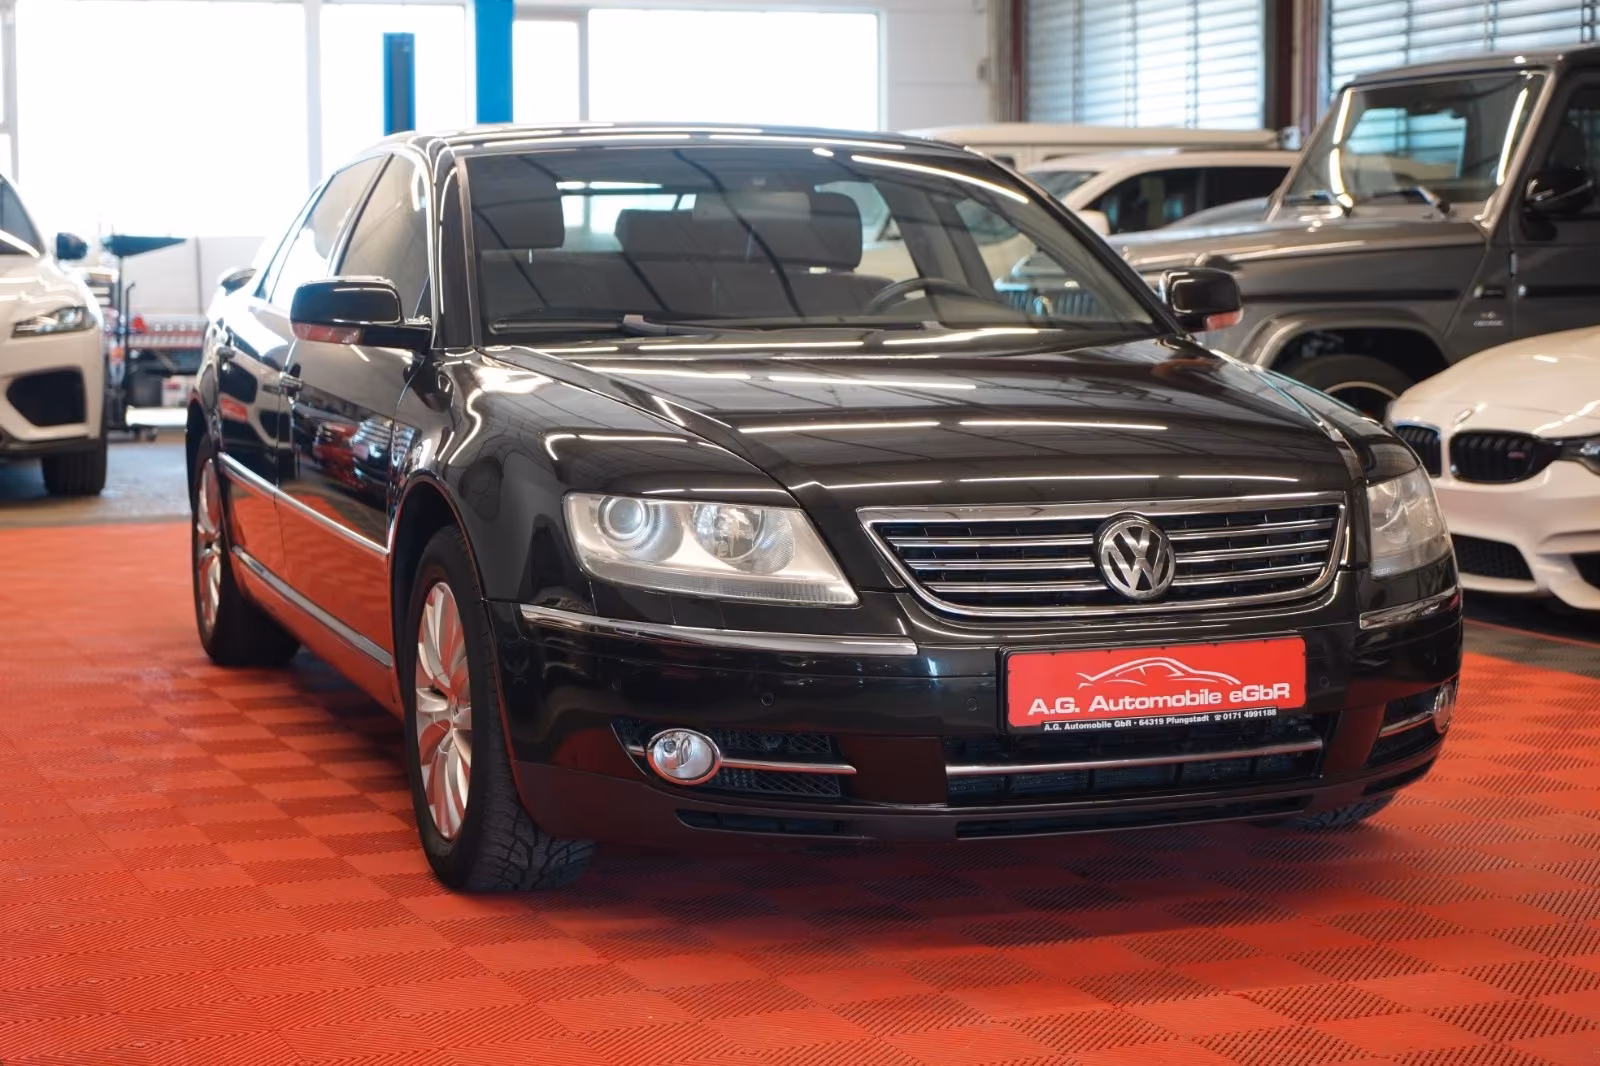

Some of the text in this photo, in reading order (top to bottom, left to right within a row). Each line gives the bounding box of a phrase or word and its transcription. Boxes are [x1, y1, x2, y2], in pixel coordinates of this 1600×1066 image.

[1027, 682, 1290, 716] A.G. Automobile eGbR
[1044, 708, 1277, 731] A.G. Automobile GbR 64319 Pfungstadt 0171 4991188
